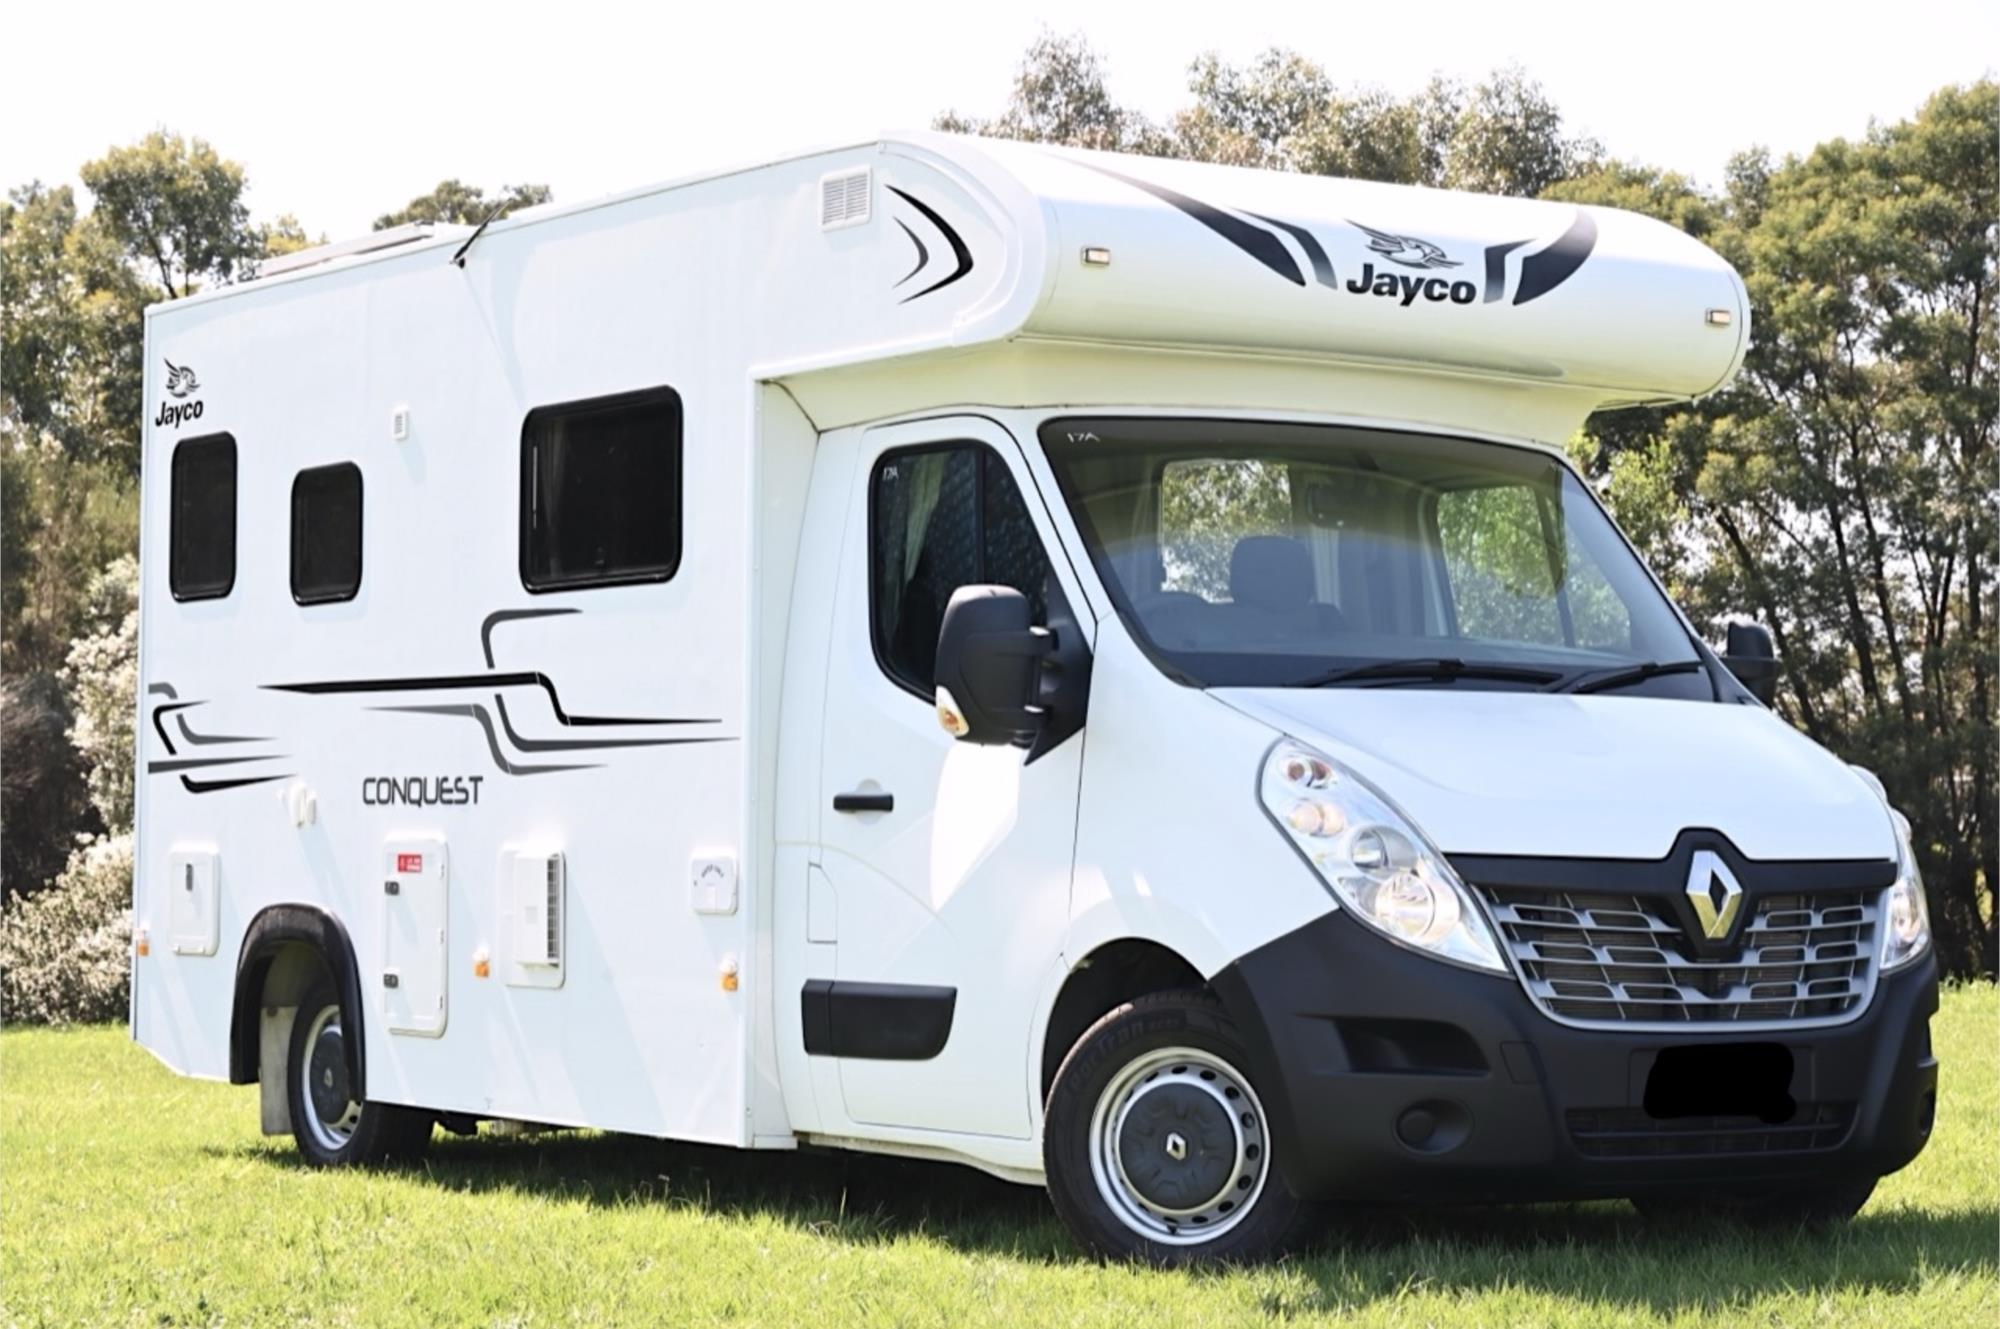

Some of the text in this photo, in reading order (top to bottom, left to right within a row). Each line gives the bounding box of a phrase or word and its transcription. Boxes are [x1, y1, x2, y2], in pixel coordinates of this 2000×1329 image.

[1346, 262, 1477, 307] Jayco
[155, 400, 204, 429] Jayco
[362, 775, 484, 808] CONQUEST
